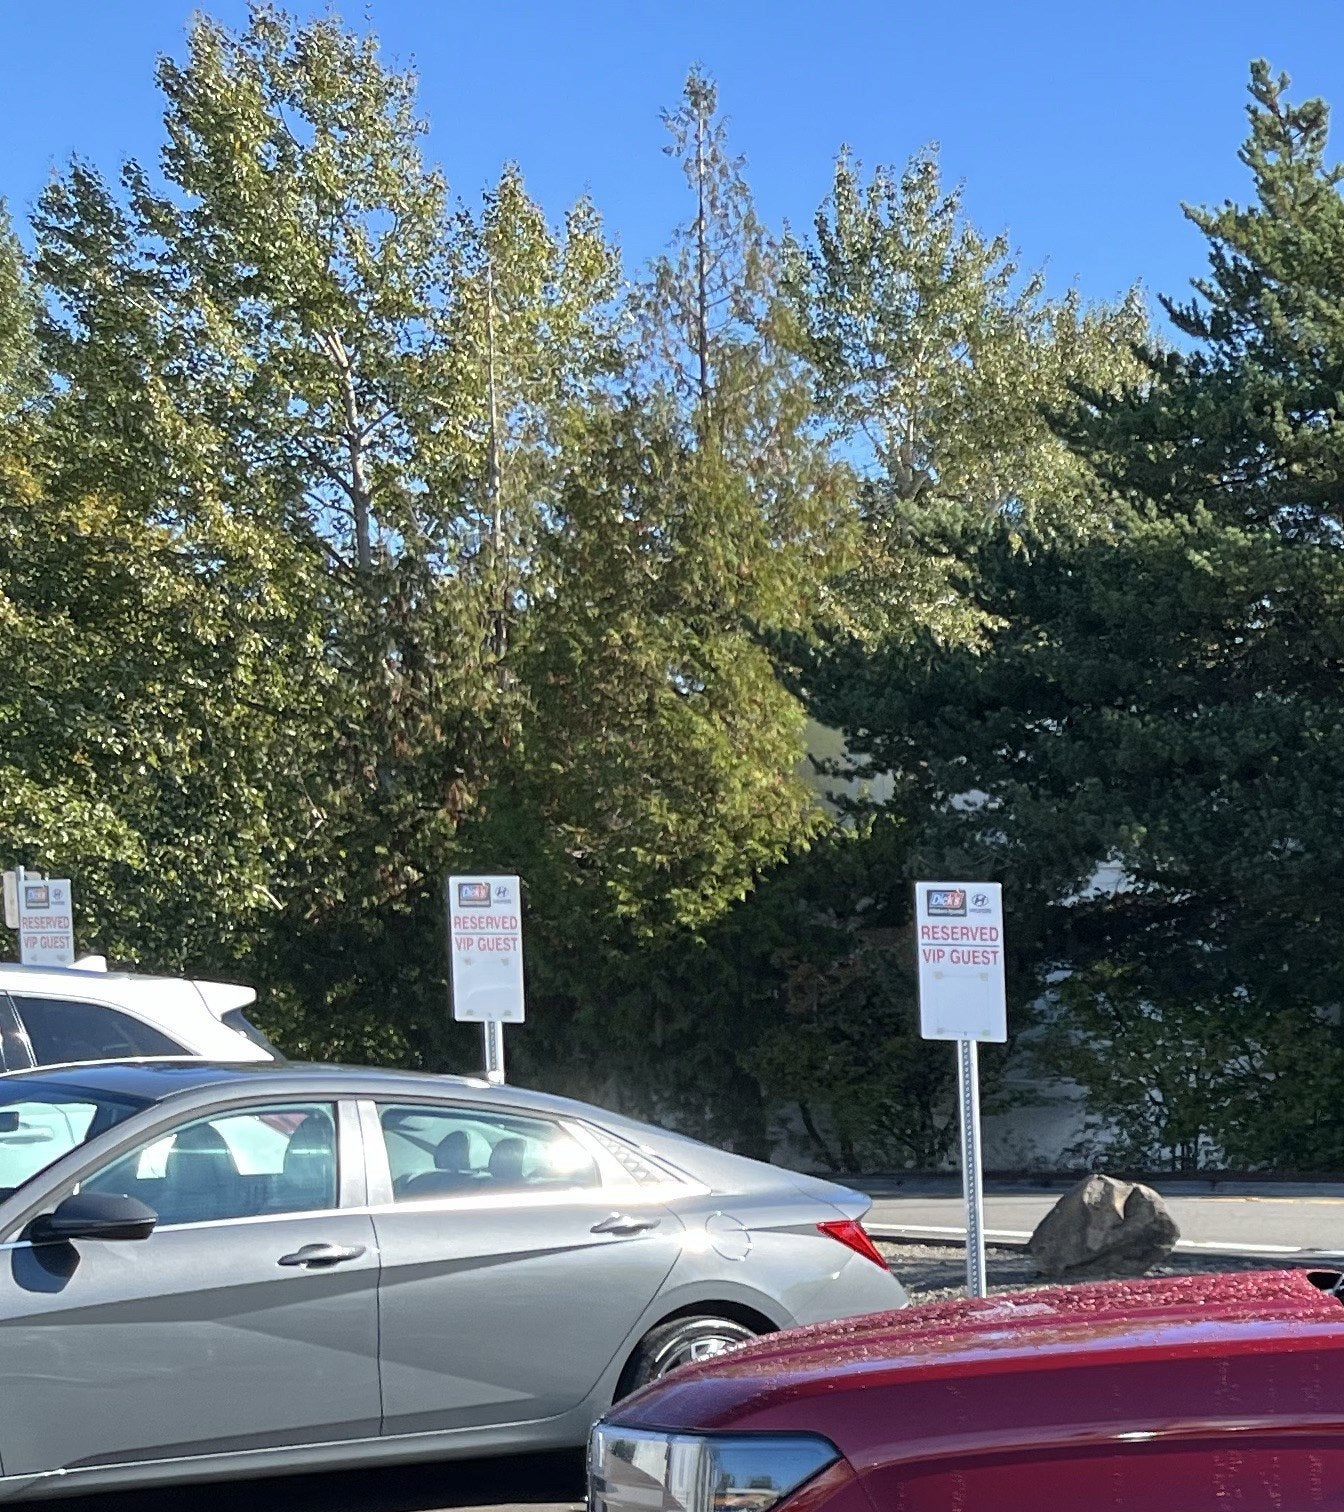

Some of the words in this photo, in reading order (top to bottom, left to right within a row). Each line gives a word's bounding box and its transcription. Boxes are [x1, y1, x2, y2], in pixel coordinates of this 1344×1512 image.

[21, 916, 70, 930] RESERVED
[453, 915, 518, 930] RESERVED
[920, 925, 999, 942] RESERVED
[23, 936, 38, 949] VIP
[40, 935, 71, 949] GUEST
[454, 937, 474, 951] VIP
[477, 936, 518, 952] GUEST
[922, 948, 945, 963] VIP
[950, 949, 999, 965] GUEST
